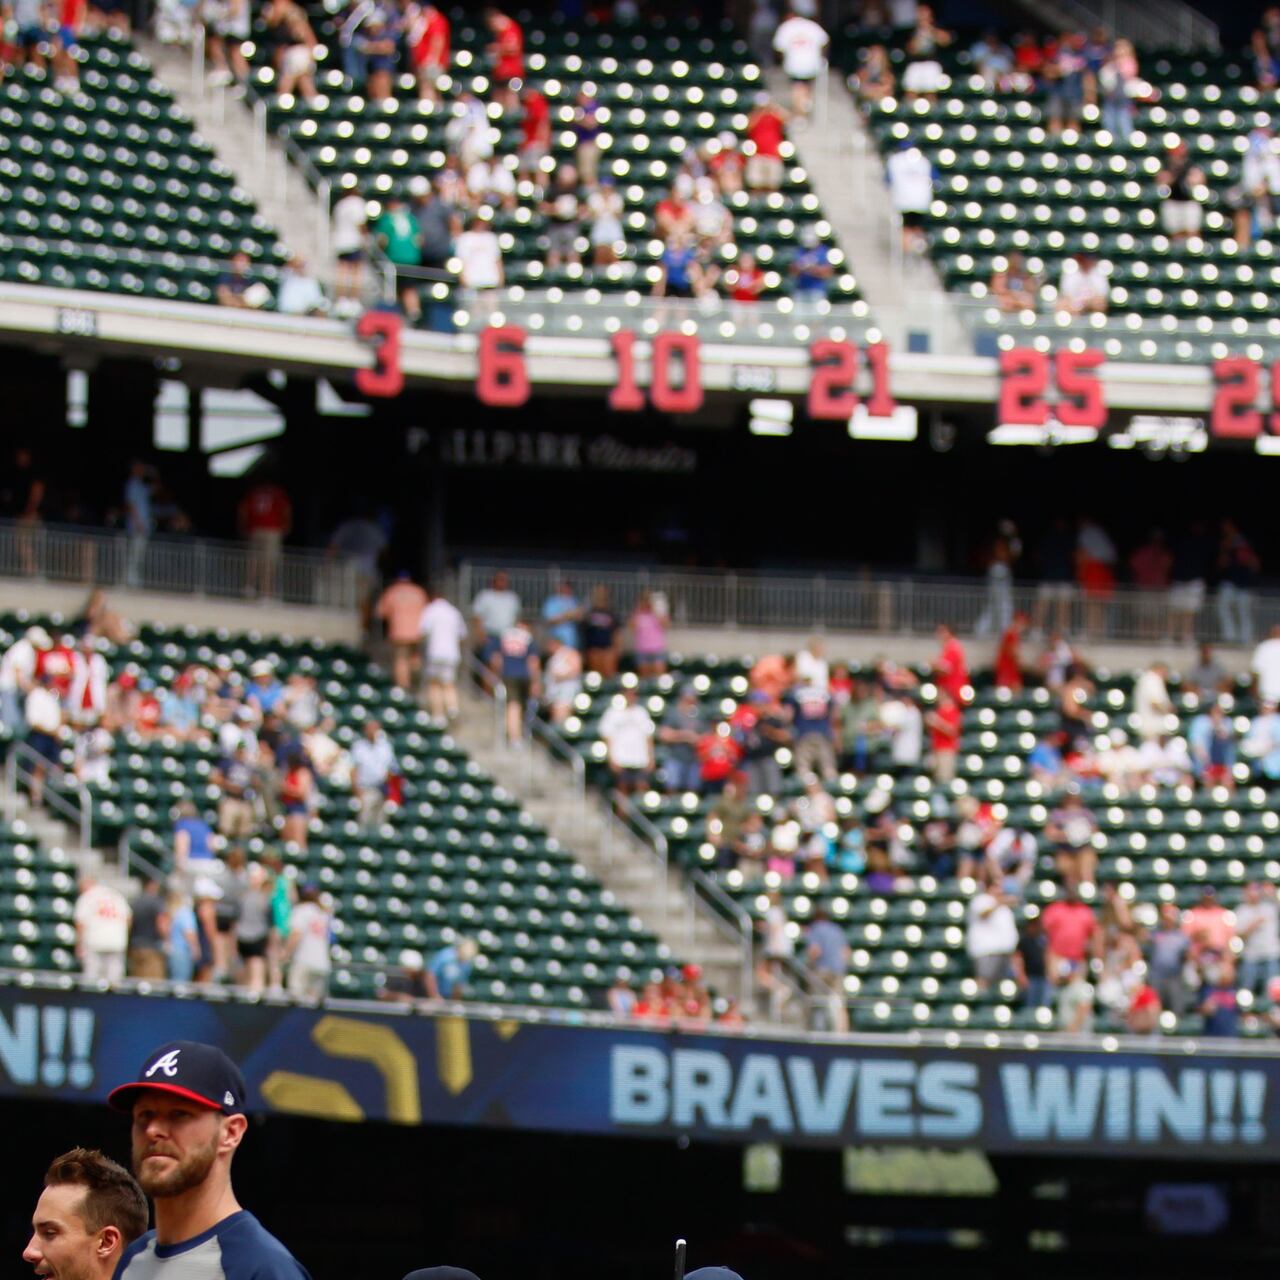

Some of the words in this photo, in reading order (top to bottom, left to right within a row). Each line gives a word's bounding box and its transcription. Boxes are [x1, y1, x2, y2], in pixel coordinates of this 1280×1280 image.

[355, 310, 405, 398] 3
[476, 323, 531, 408] 6
[608, 328, 705, 413] 10
[808, 338, 897, 420] 21
[998, 346, 1109, 429] 25
[145, 1049, 182, 1078] A
[610, 1044, 983, 1138] BRAVES
[1000, 1062, 1268, 1144] WIN!!
